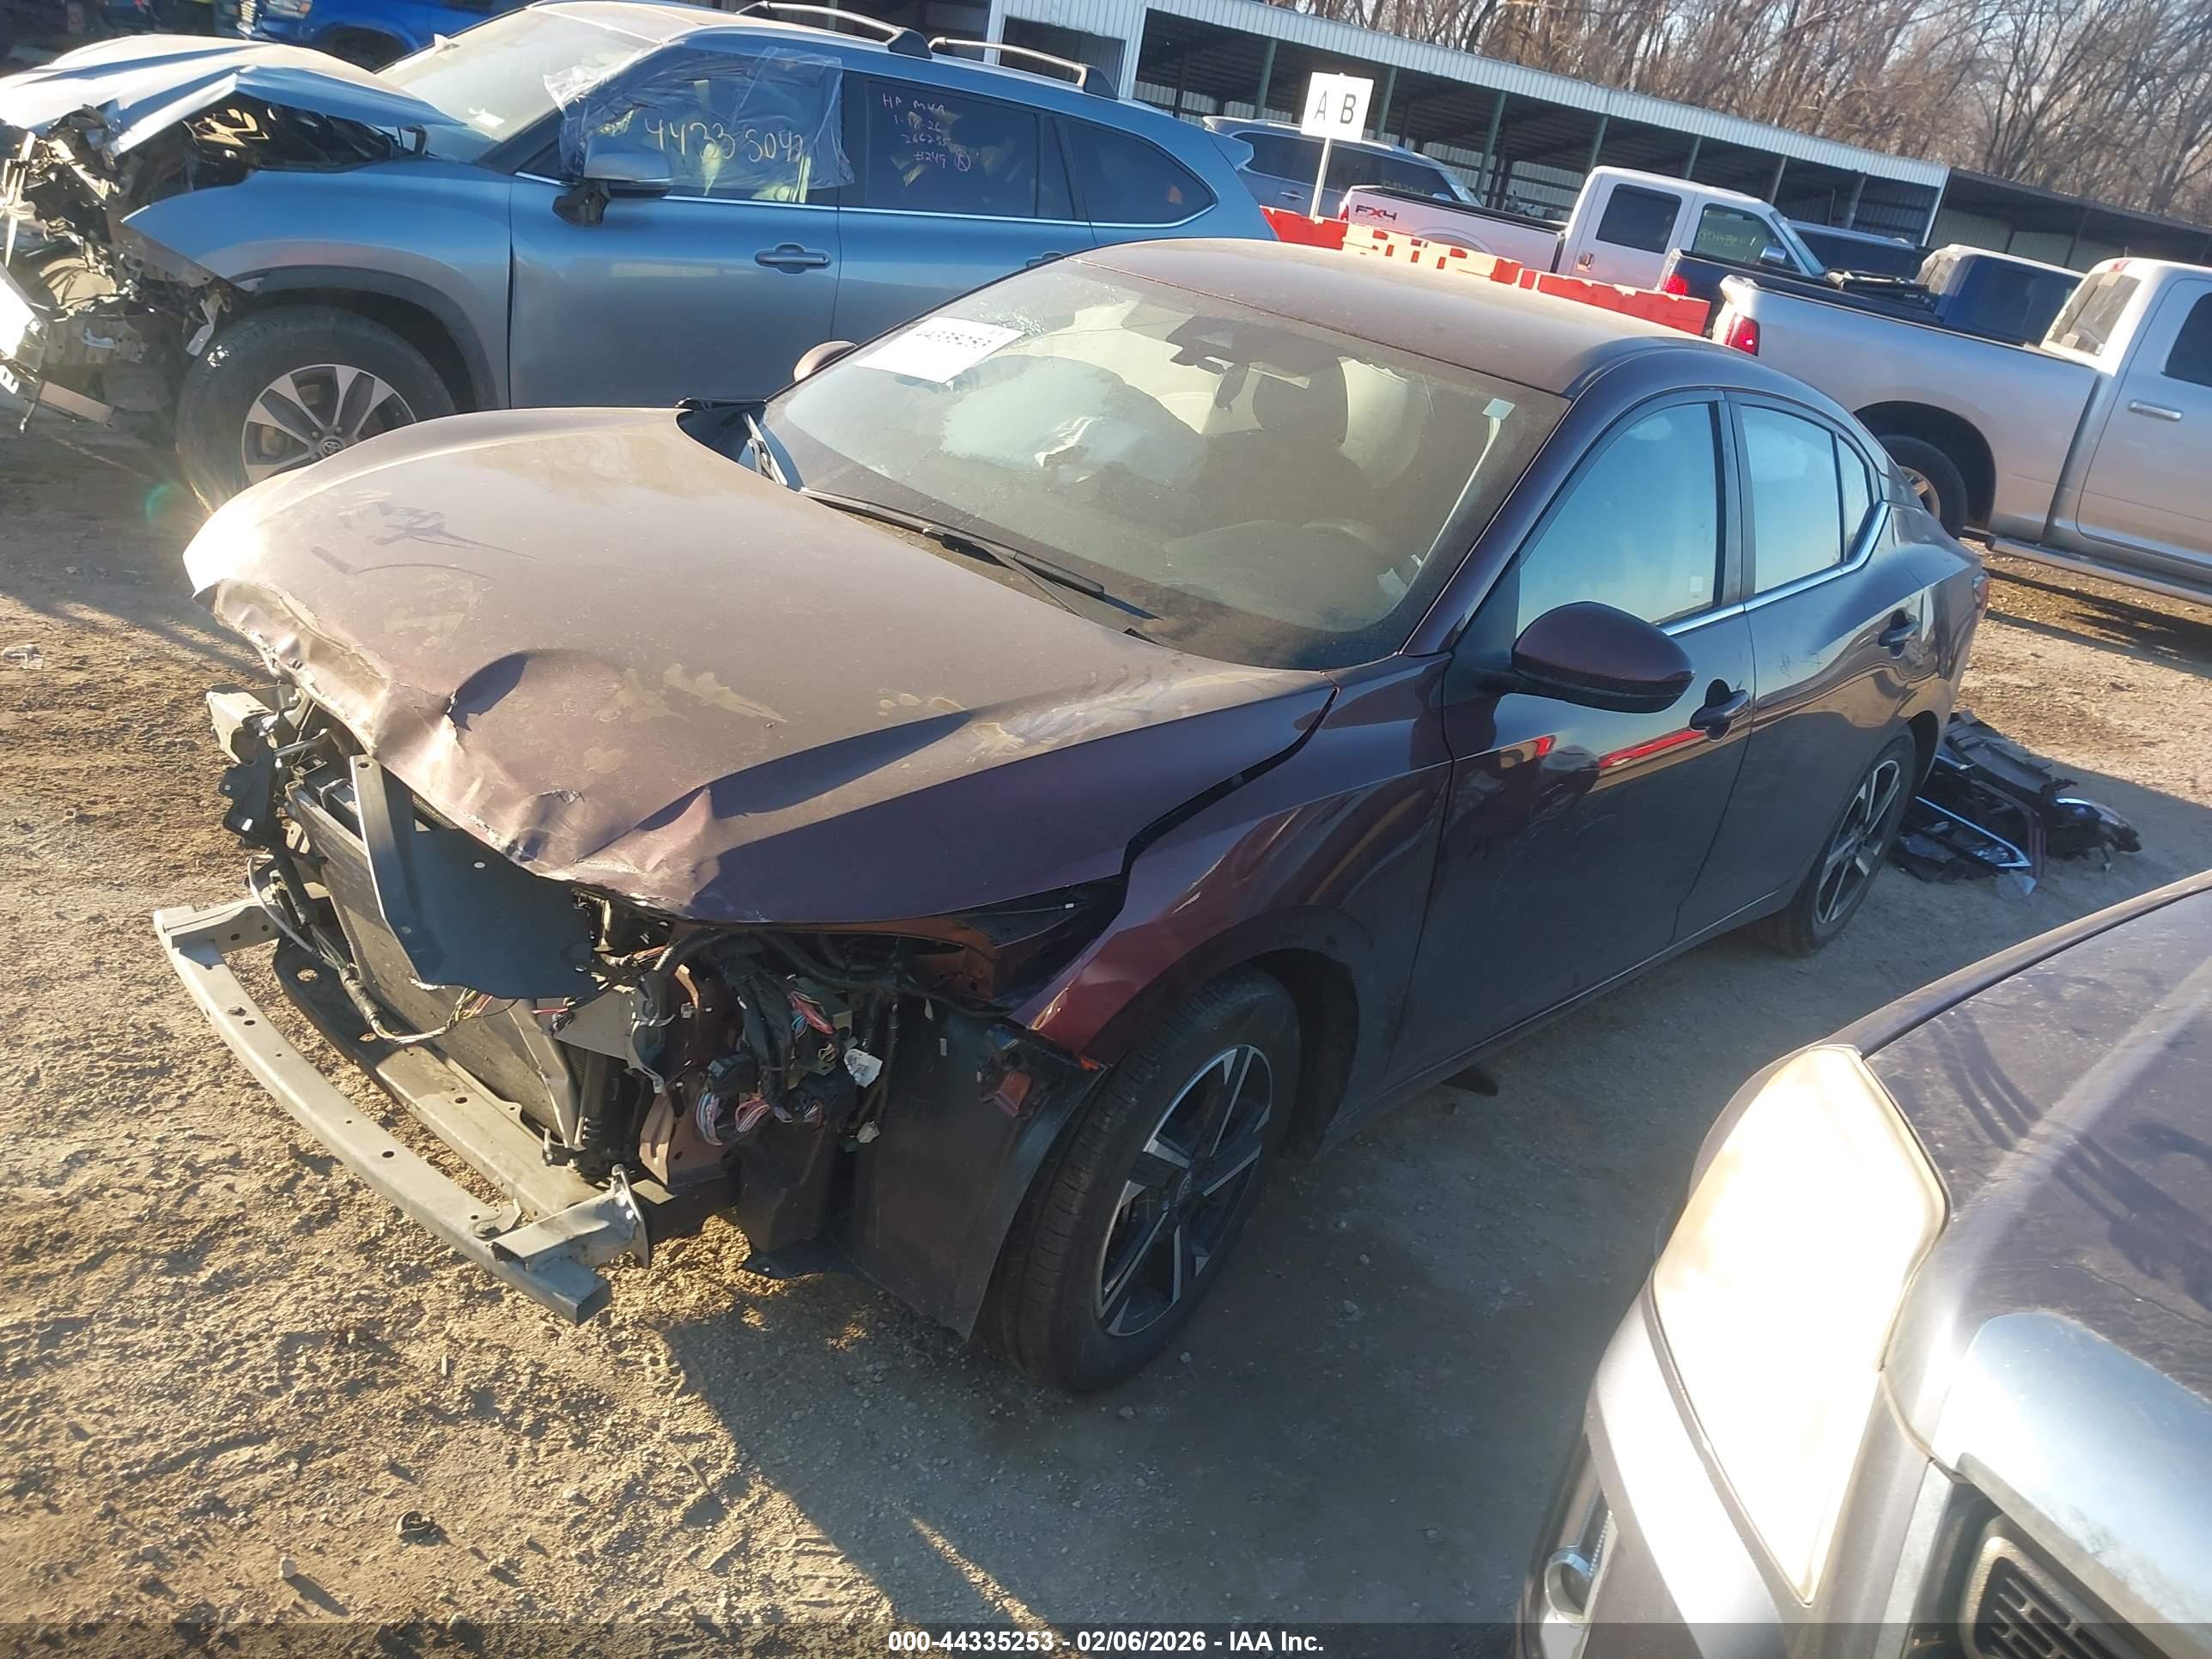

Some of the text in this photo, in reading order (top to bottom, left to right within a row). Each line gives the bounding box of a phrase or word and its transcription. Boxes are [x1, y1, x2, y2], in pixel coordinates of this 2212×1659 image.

[1314, 90, 1357, 124] A B
[1355, 204, 1397, 221] FX4
